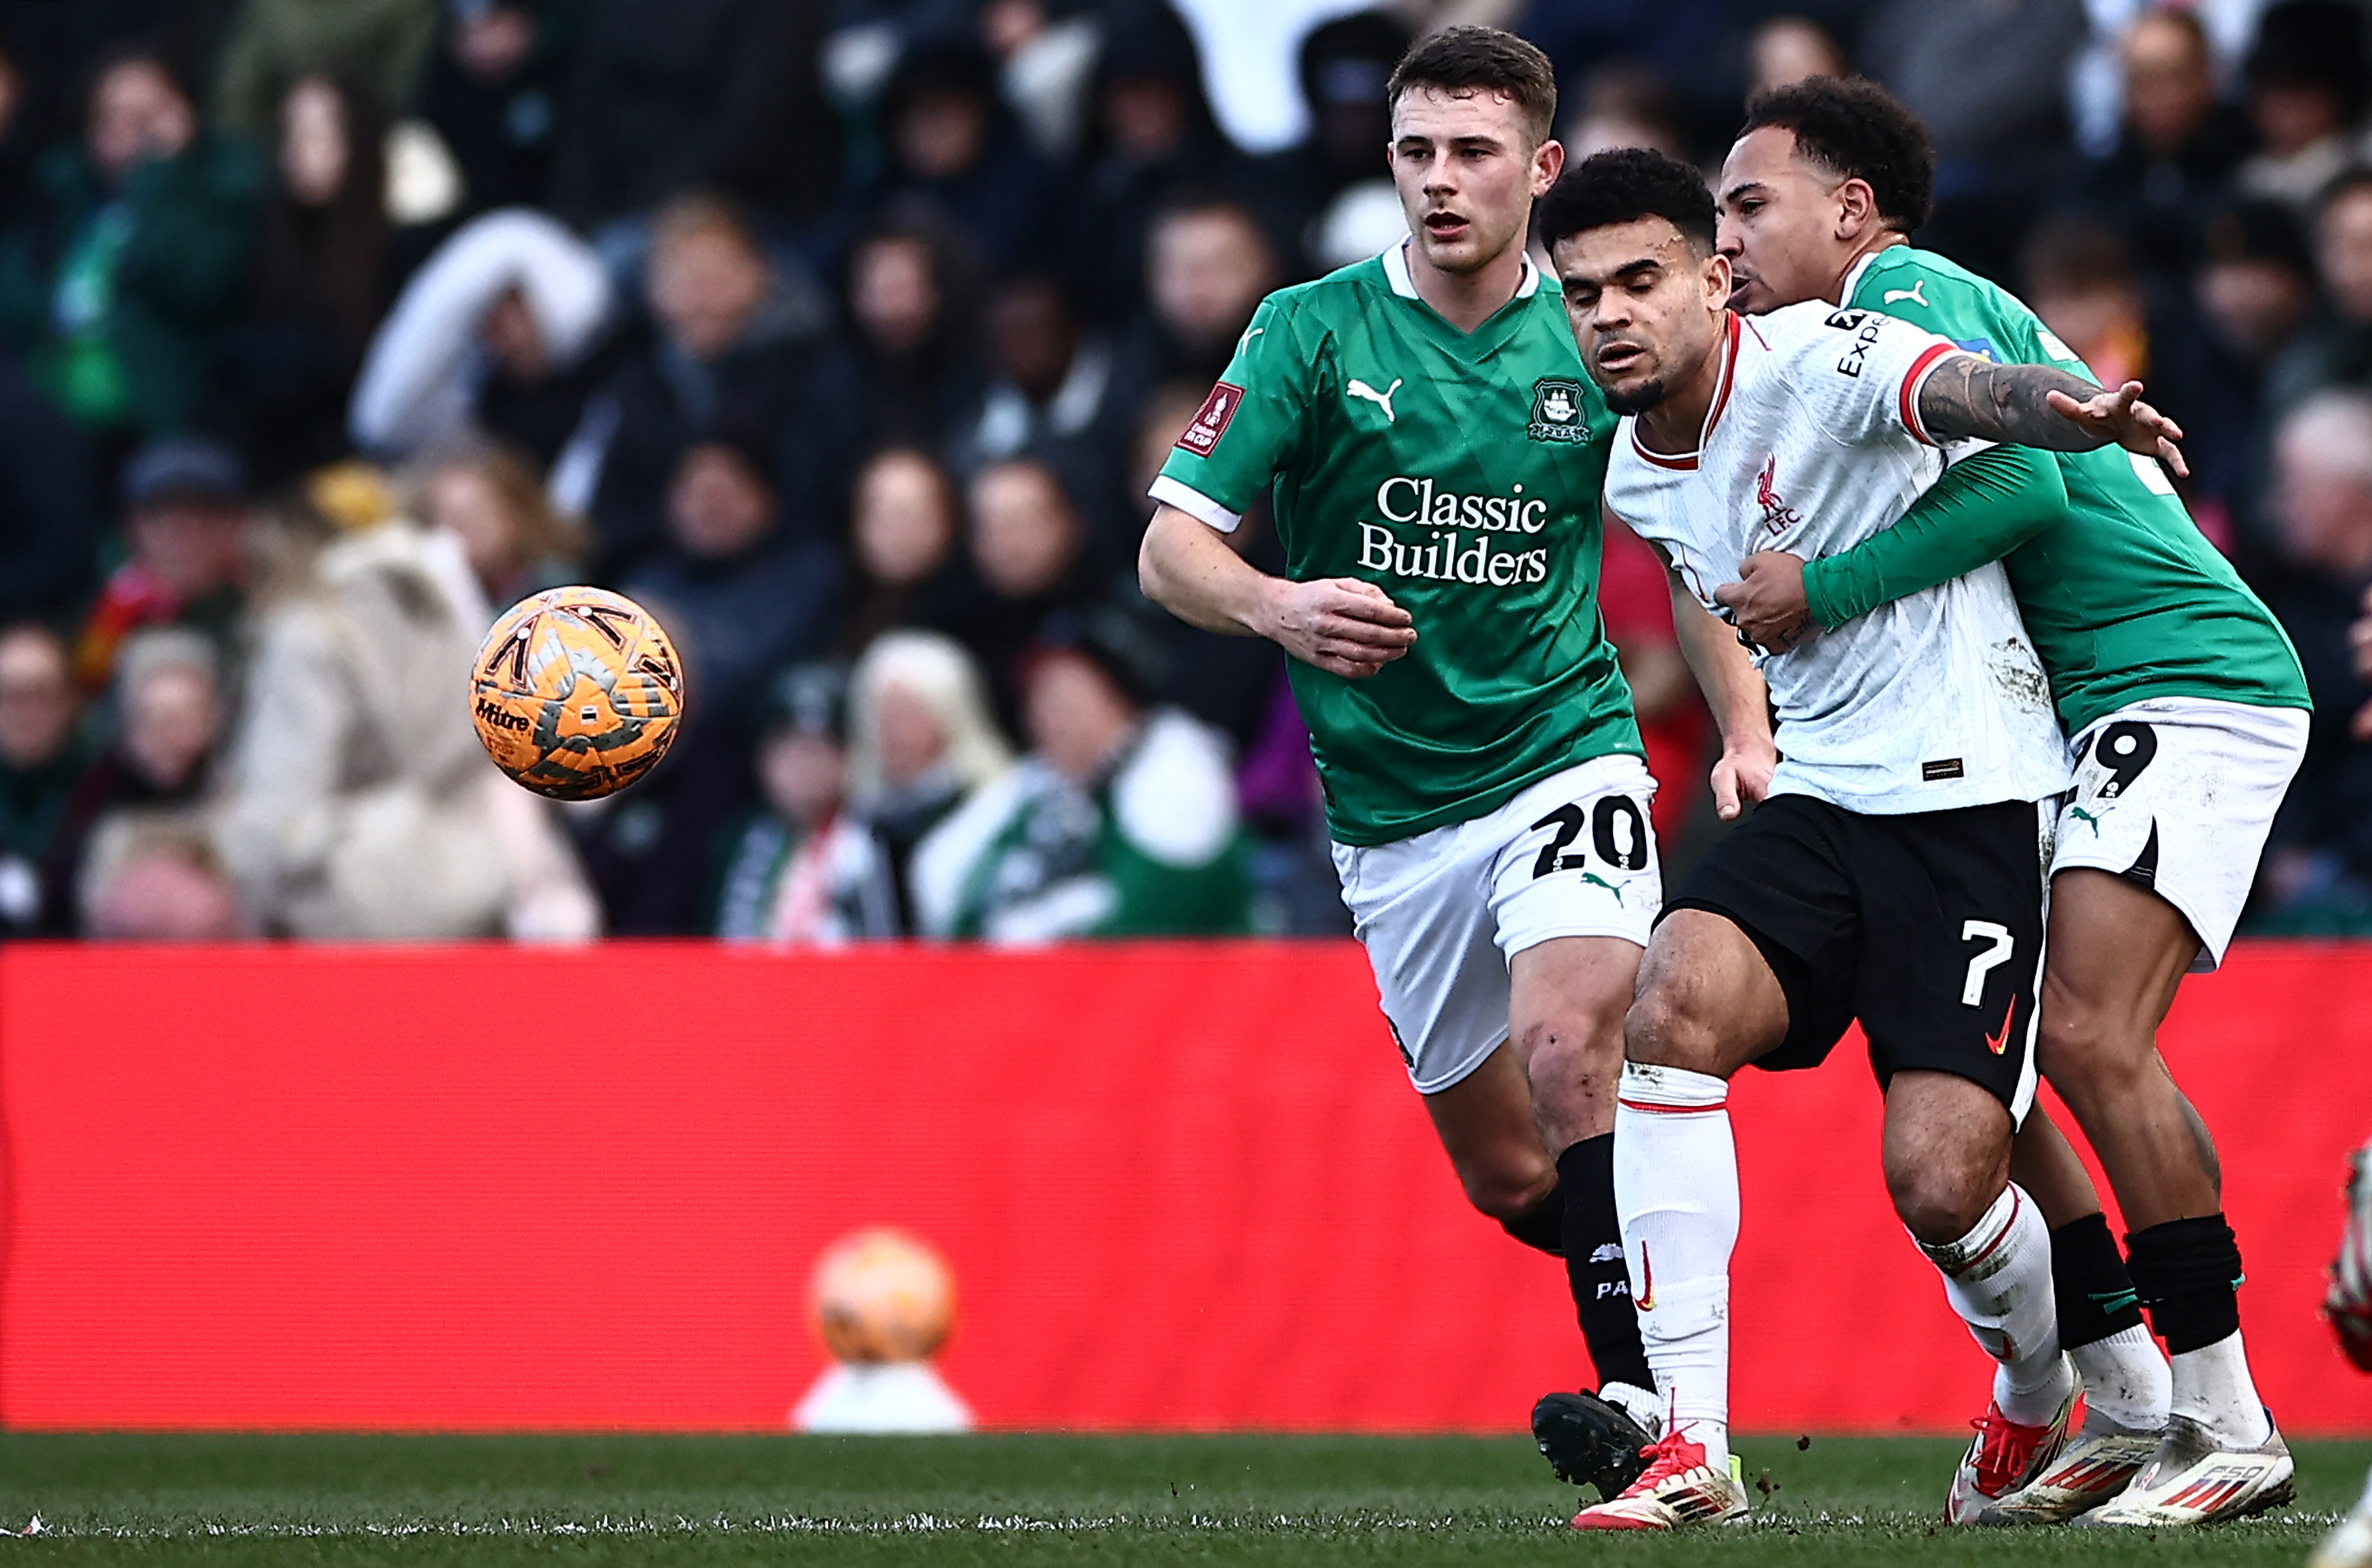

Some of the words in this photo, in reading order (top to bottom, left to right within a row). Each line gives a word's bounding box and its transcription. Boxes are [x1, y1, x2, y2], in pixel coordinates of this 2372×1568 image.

[1837, 316, 1891, 378] Expe
[1377, 477, 1547, 534] Classic
[1357, 521, 1547, 586] Builders
[475, 697, 529, 731] Mitre
[1530, 794, 1648, 879] 20
[1962, 920, 2014, 1006] 7
[1596, 1280, 1629, 1300] PA
[2203, 1465, 2265, 1479] F50
